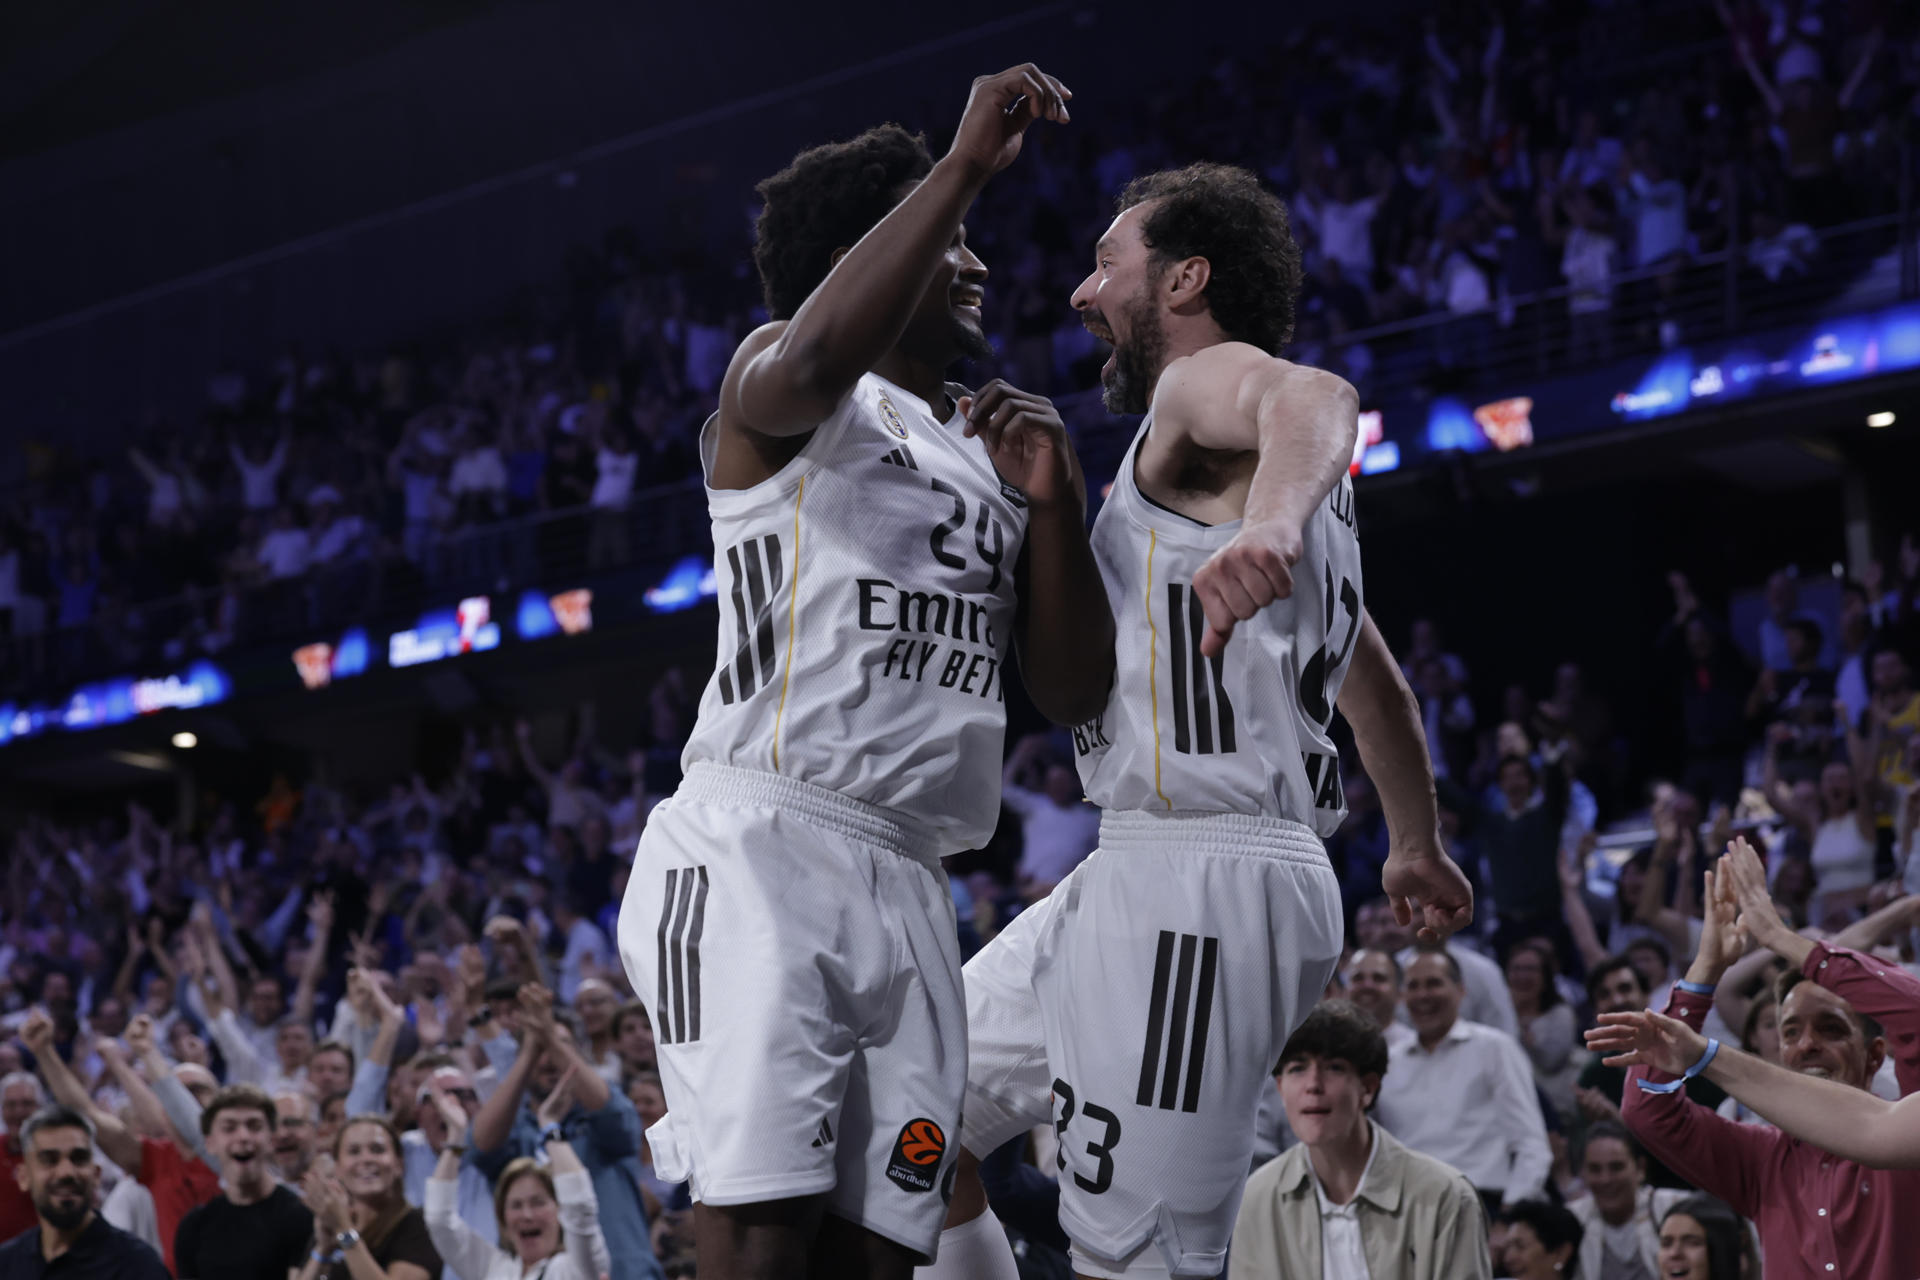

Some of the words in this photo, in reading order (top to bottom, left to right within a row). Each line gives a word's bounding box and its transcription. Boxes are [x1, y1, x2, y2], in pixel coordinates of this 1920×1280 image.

[930, 477, 1004, 591] 24
[856, 578, 996, 649] Emir
[883, 638, 938, 682] FLY
[939, 649, 1003, 702] BET
[1052, 1077, 1122, 1195] 23
[889, 1169, 906, 1180] abu
[906, 1174, 931, 1189] dhabi
